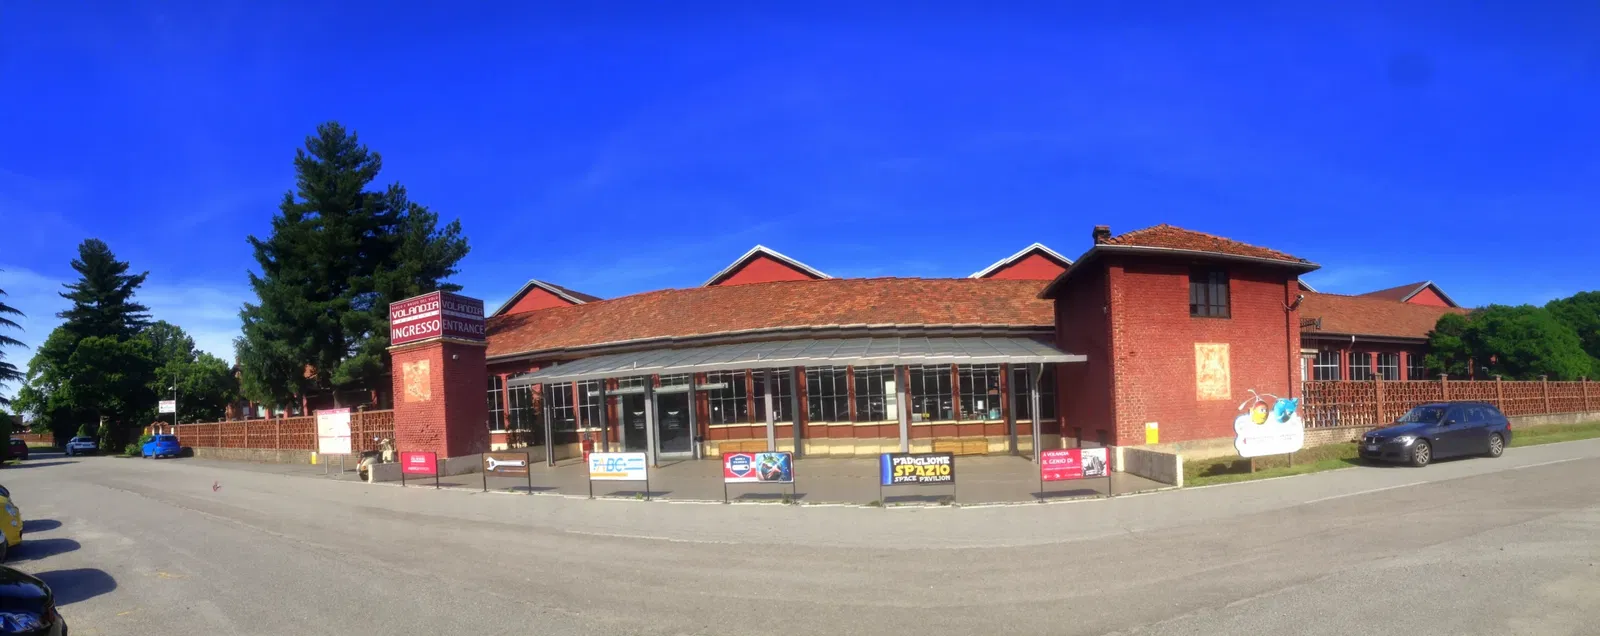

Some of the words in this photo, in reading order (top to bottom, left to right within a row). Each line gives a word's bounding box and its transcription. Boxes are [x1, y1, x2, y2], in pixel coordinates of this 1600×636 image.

[392, 301, 439, 319] VOLANDIA
[442, 300, 483, 315] VOLANDIA
[392, 319, 440, 340] INGRESSO
[443, 319, 484, 334] ENTRANCE
[892, 456, 950, 466] PADIGLIONE
[894, 464, 951, 477] SPAZIO
[920, 474, 951, 482] PAVILION
